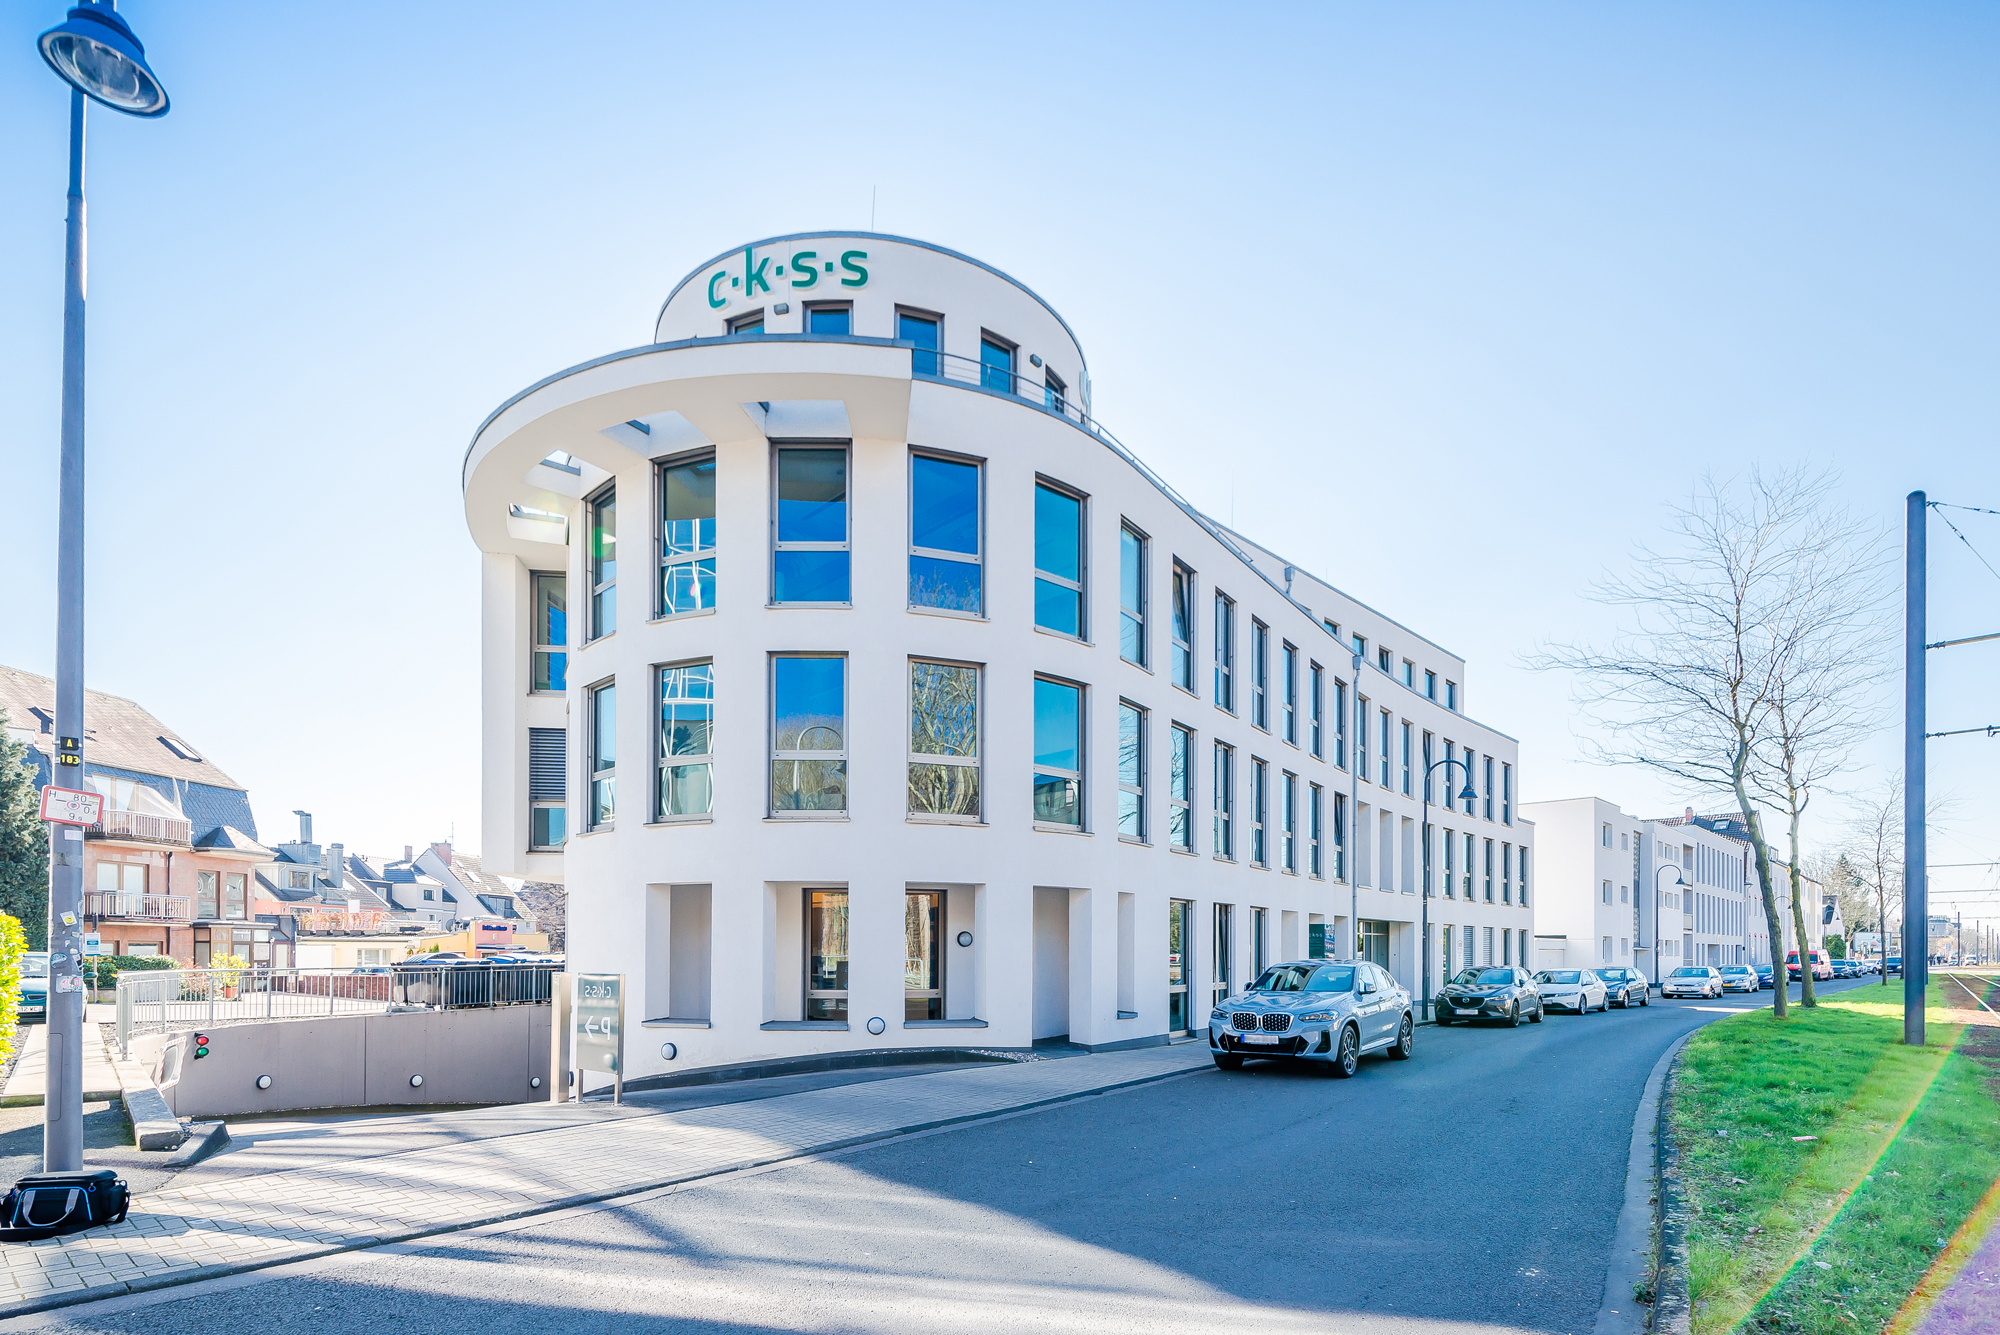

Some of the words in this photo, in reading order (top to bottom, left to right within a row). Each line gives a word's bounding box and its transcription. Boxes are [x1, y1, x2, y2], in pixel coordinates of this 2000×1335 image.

[66, 738, 73, 748] A
[60, 754, 79, 765] 183
[49, 790, 57, 798] H
[73, 794, 87, 803] 80
